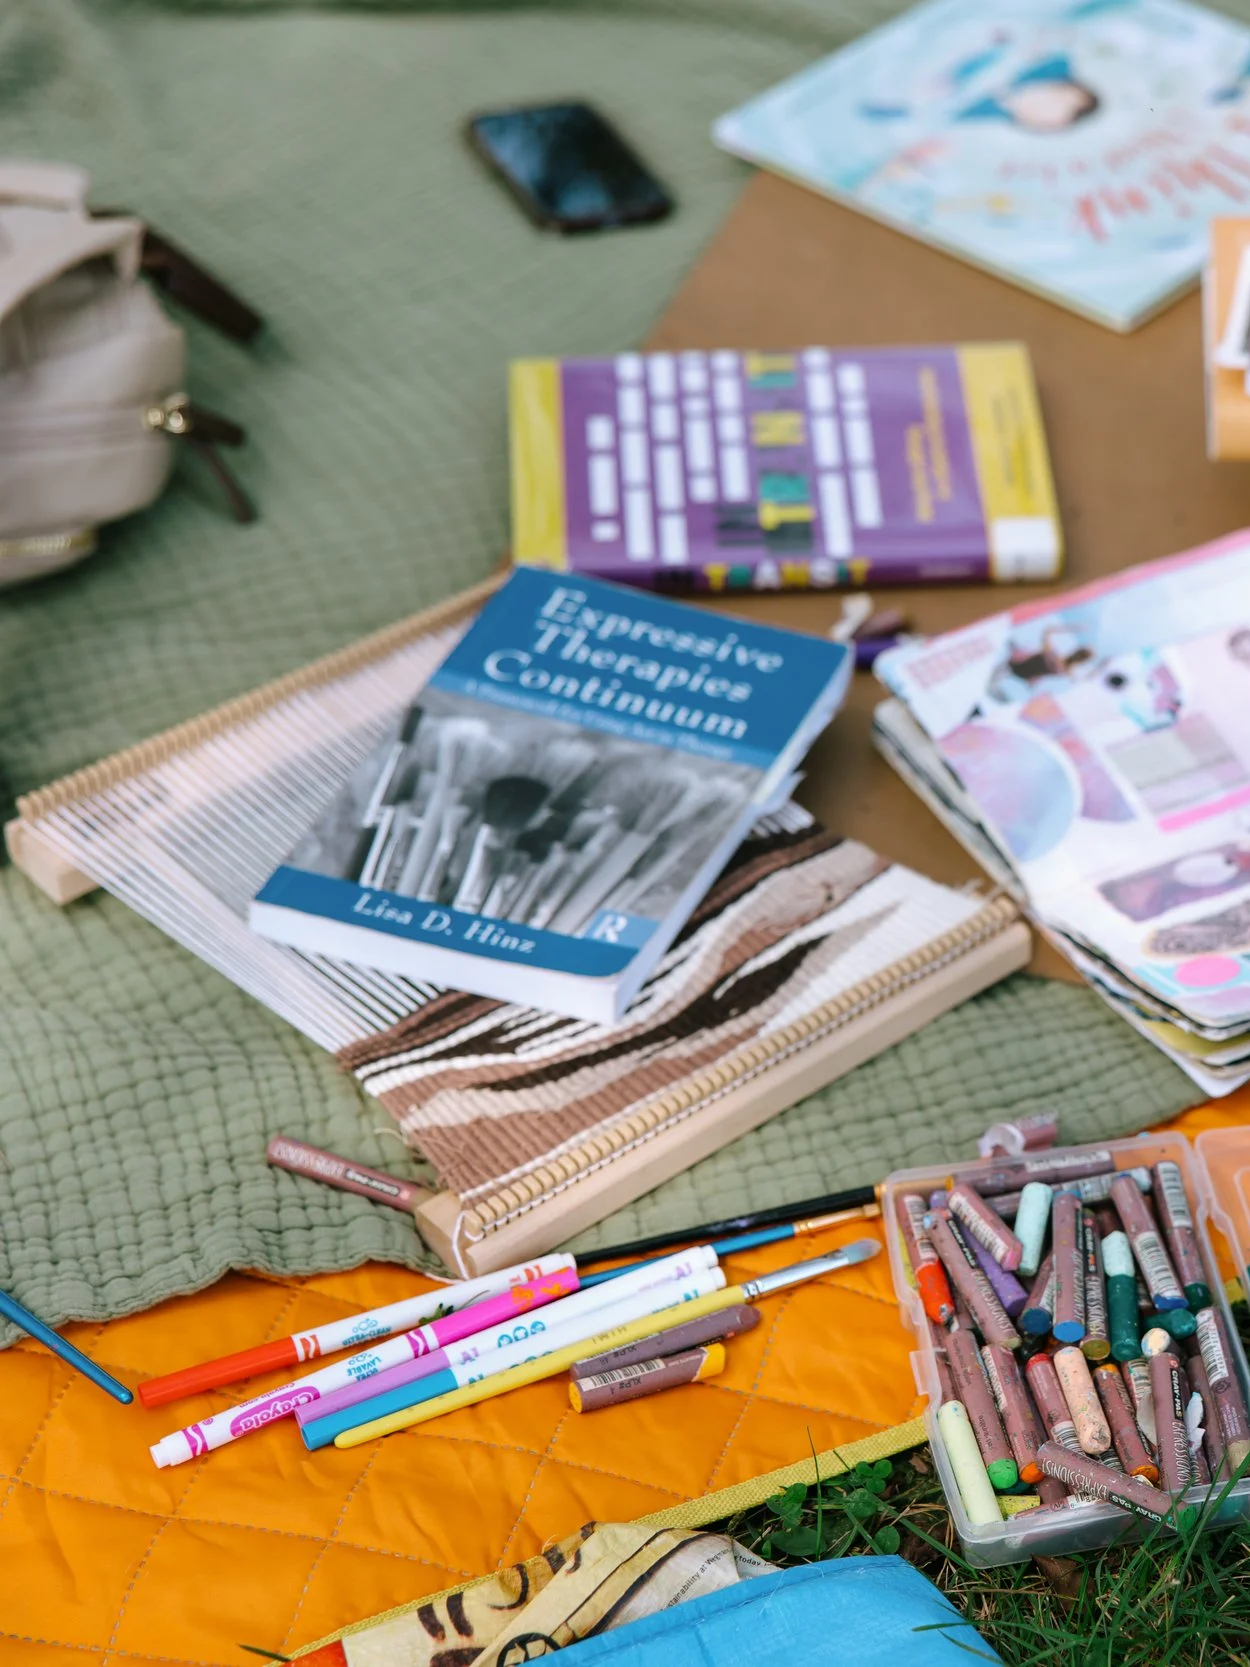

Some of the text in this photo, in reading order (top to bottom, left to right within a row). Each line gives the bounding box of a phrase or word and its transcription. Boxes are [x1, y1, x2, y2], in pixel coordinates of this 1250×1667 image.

[540, 586, 784, 674] Expressive
[533, 617, 753, 704] Therapies
[484, 649, 748, 740] Continuum
[352, 890, 537, 954] Lisa D. Hinz
[592, 913, 629, 943] R
[346, 1355, 383, 1376] LAVABLE
[619, 1376, 642, 1390] XLP#
[240, 1391, 312, 1432] Crayola
[1041, 1458, 1109, 1501] EXPRESSIONIST
[738, 1554, 762, 1567] today
[660, 1571, 702, 1612] stainability
[700, 1564, 707, 1574] at
